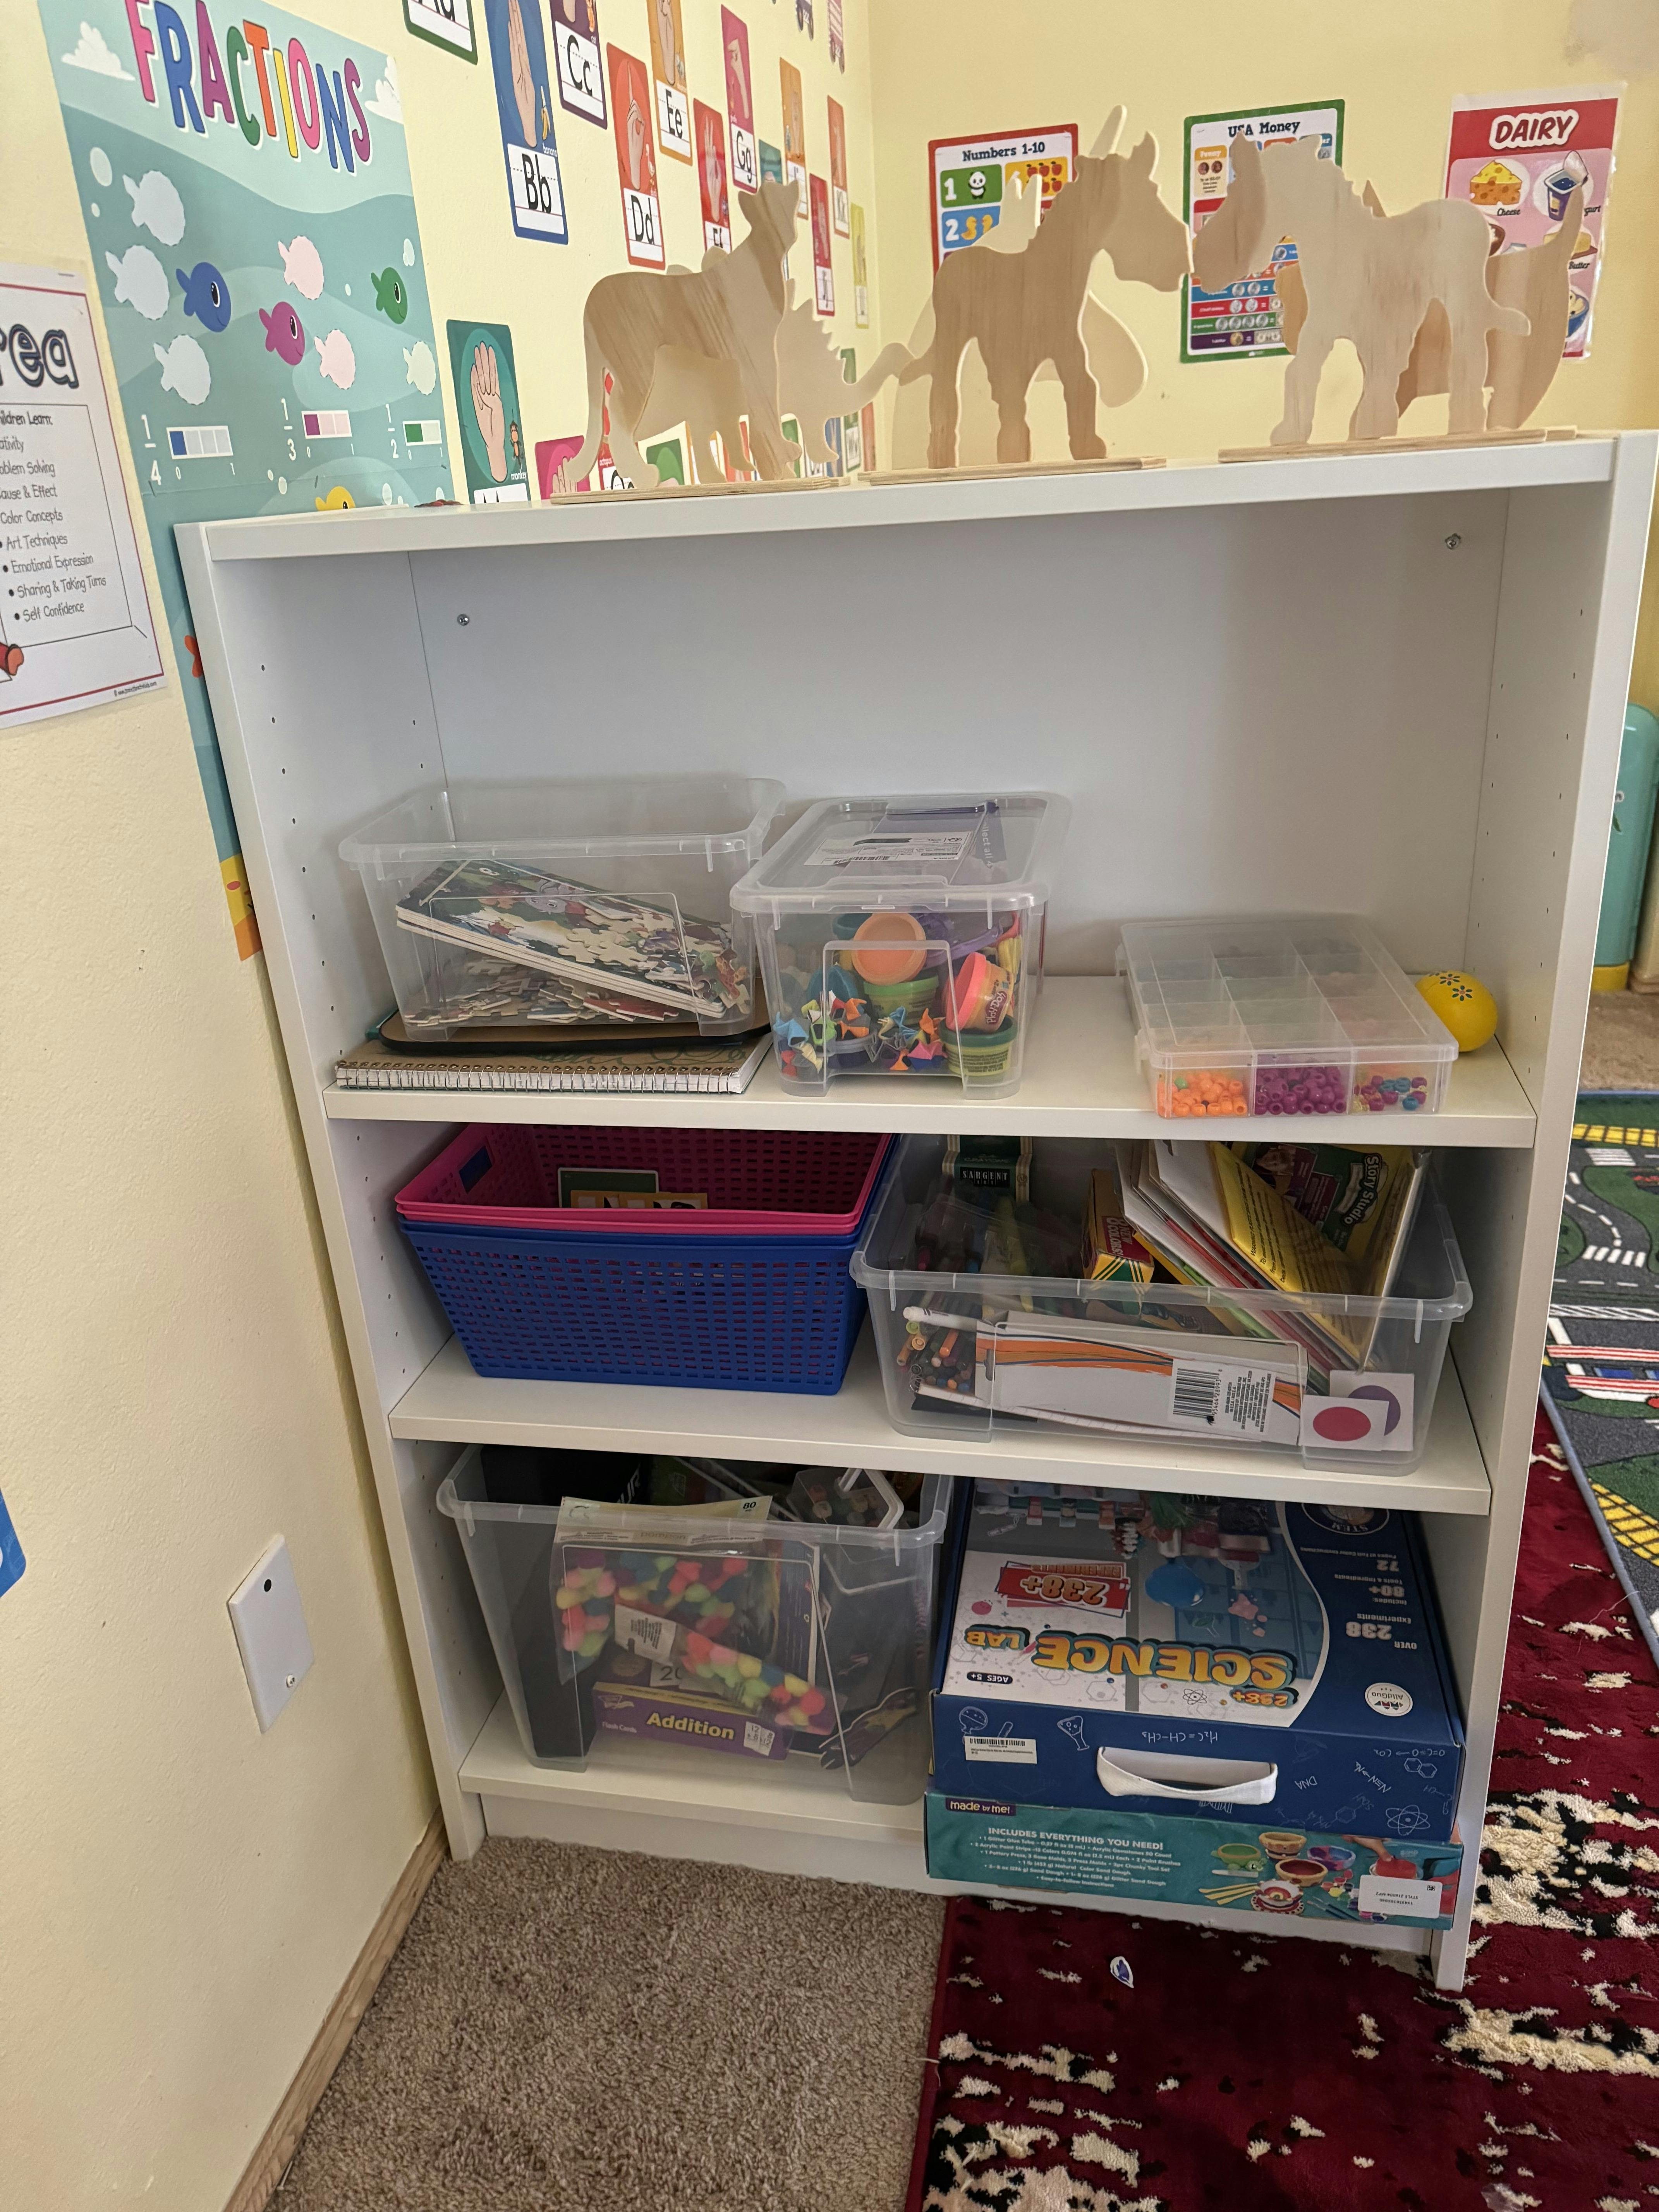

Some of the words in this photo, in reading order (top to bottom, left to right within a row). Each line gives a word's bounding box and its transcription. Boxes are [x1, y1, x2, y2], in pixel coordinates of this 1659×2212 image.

[567, 34, 592, 96] Cc
[125, 0, 371, 173] FRACTIONS
[665, 89, 684, 140] Ee
[1259, 121, 1300, 134] Money
[1494, 115, 1573, 143] DAIRY
[736, 131, 752, 184] Gg
[962, 147, 1017, 162] Numbers
[1022, 142, 1045, 154] 1-10
[522, 153, 552, 214] Bb
[944, 177, 957, 201] 1
[630, 194, 655, 245] Dd
[1496, 207, 1521, 217] Cheese
[945, 218, 959, 241] 2
[27, 411, 53, 425] Learn:
[141, 414, 151, 440] 1
[287, 438, 297, 461] 3
[390, 439, 399, 459] 2
[27, 459, 56, 477] Solving
[151, 460, 161, 485] 4
[23, 485, 31, 498] &
[32, 484, 58, 499] Effect
[0, 510, 24, 524] Color
[26, 507, 63, 524] Concepts
[7, 536, 22, 551] Art
[25, 532, 68, 550] Techniques
[12, 558, 53, 574] Emotional
[54, 551, 94, 571] Expression
[17, 584, 52, 599] Sharing
[53, 580, 60, 593] &
[61, 577, 87, 593] Taking
[86, 575, 107, 586] Turns
[22, 606, 41, 622] Self
[44, 602, 85, 618] Confidence
[986, 991, 1008, 1024] Play-Doh
[963, 1170, 1008, 1180] SARGENT
[1364, 1156, 1379, 1189] Story
[1344, 1191, 1374, 1224] Studio
[1108, 1224, 1124, 1255] COLORS!
[1376, 1559, 1400, 1572] 72
[1021, 1576, 1106, 1606] 238+
[1357, 1613, 1412, 1624] Experiments
[965, 1630, 1020, 1649] LAB
[1346, 1621, 1392, 1640] 238
[1394, 1641, 1417, 1650] OVER
[1032, 1636, 1286, 1689] SCIENCE
[971, 1672, 983, 1681] 5+
[987, 1674, 1010, 1683] AGES
[1231, 1691, 1288, 1706] 238+
[646, 1712, 735, 1740] Addition
[1294, 1776, 1317, 1790] DNA
[950, 1801, 980, 1811] made
[988, 1827, 1037, 1838] INCLUDES
[1040, 1831, 1104, 1845] EVERYTHING
[1107, 1838, 1130, 1846] YOU
[1132, 1840, 1163, 1850] NEED!
